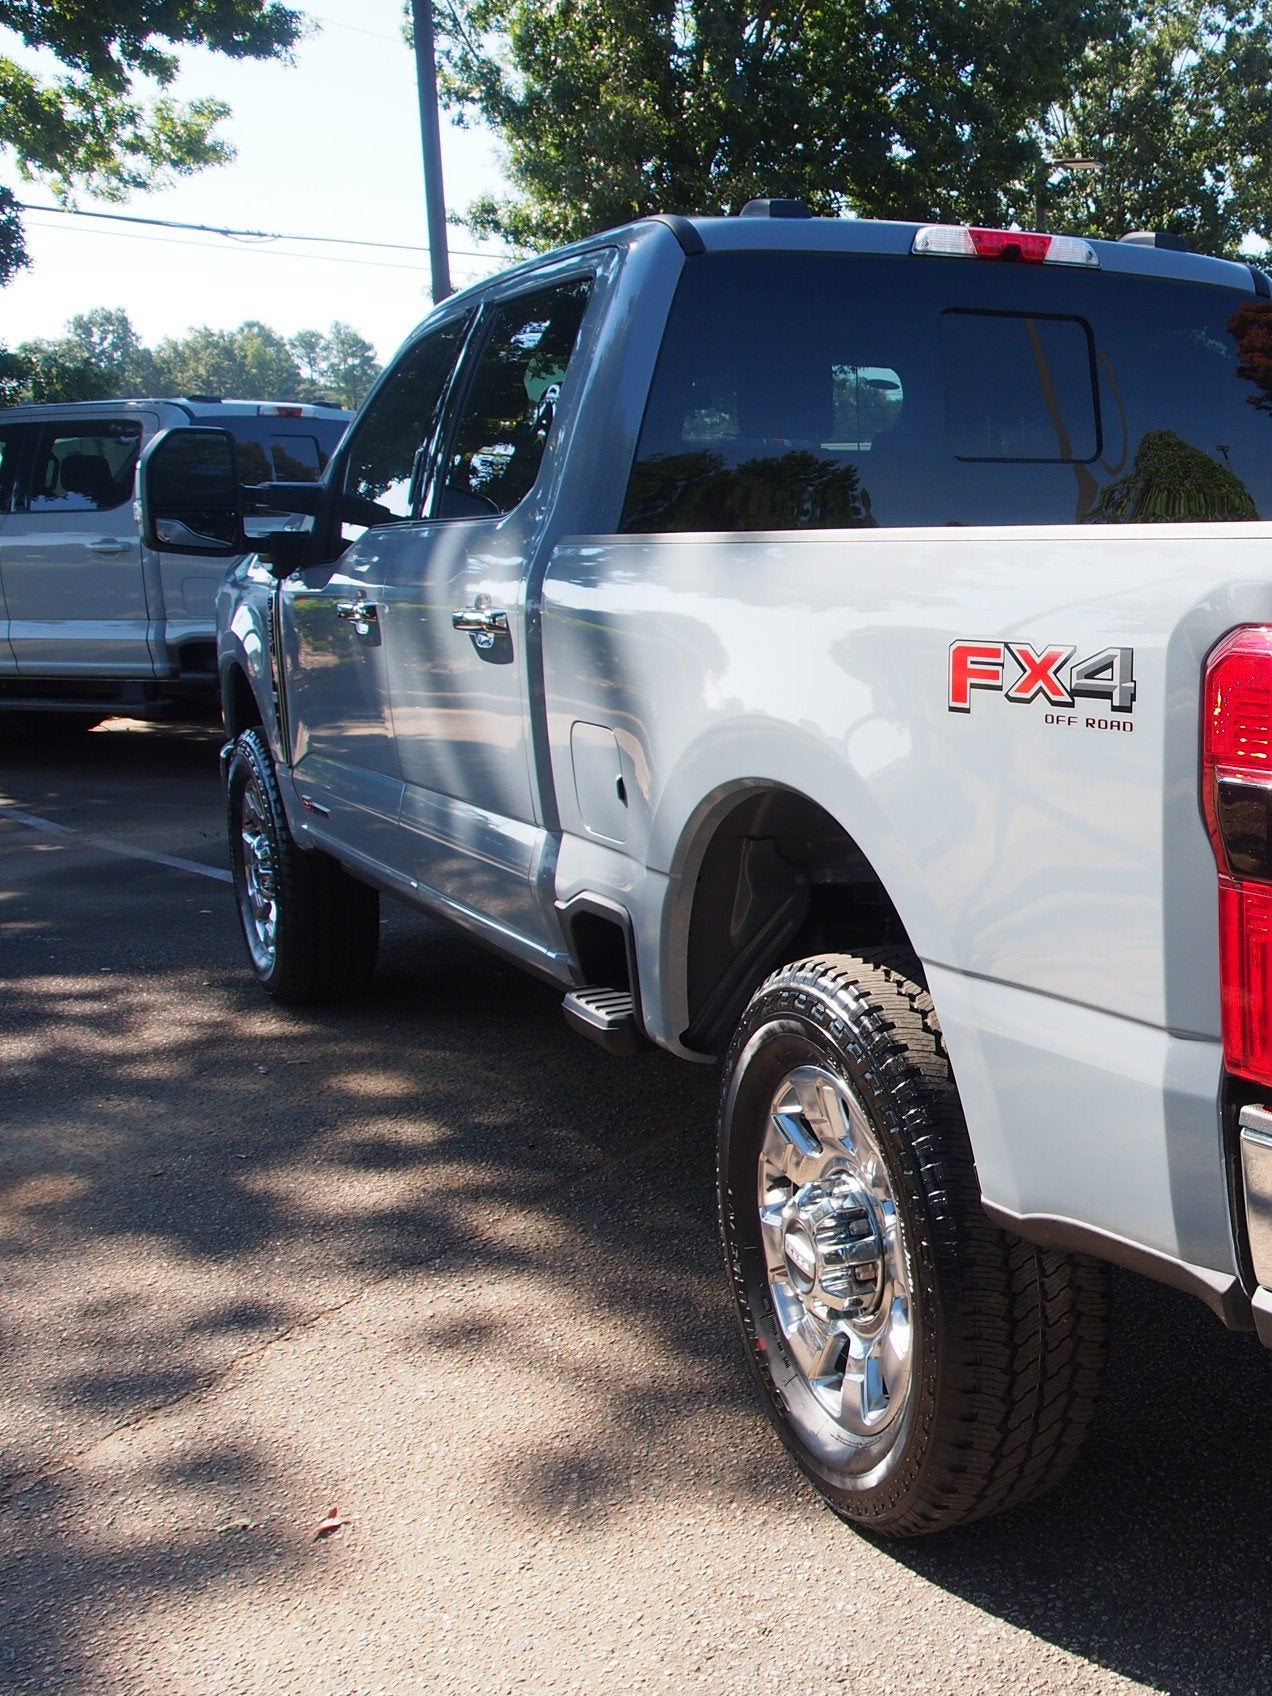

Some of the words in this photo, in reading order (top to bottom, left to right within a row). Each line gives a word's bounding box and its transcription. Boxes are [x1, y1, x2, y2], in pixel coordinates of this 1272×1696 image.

[948, 639, 1136, 714] FX4
[1045, 713, 1078, 726] OFF
[1085, 717, 1134, 732] ROAD
